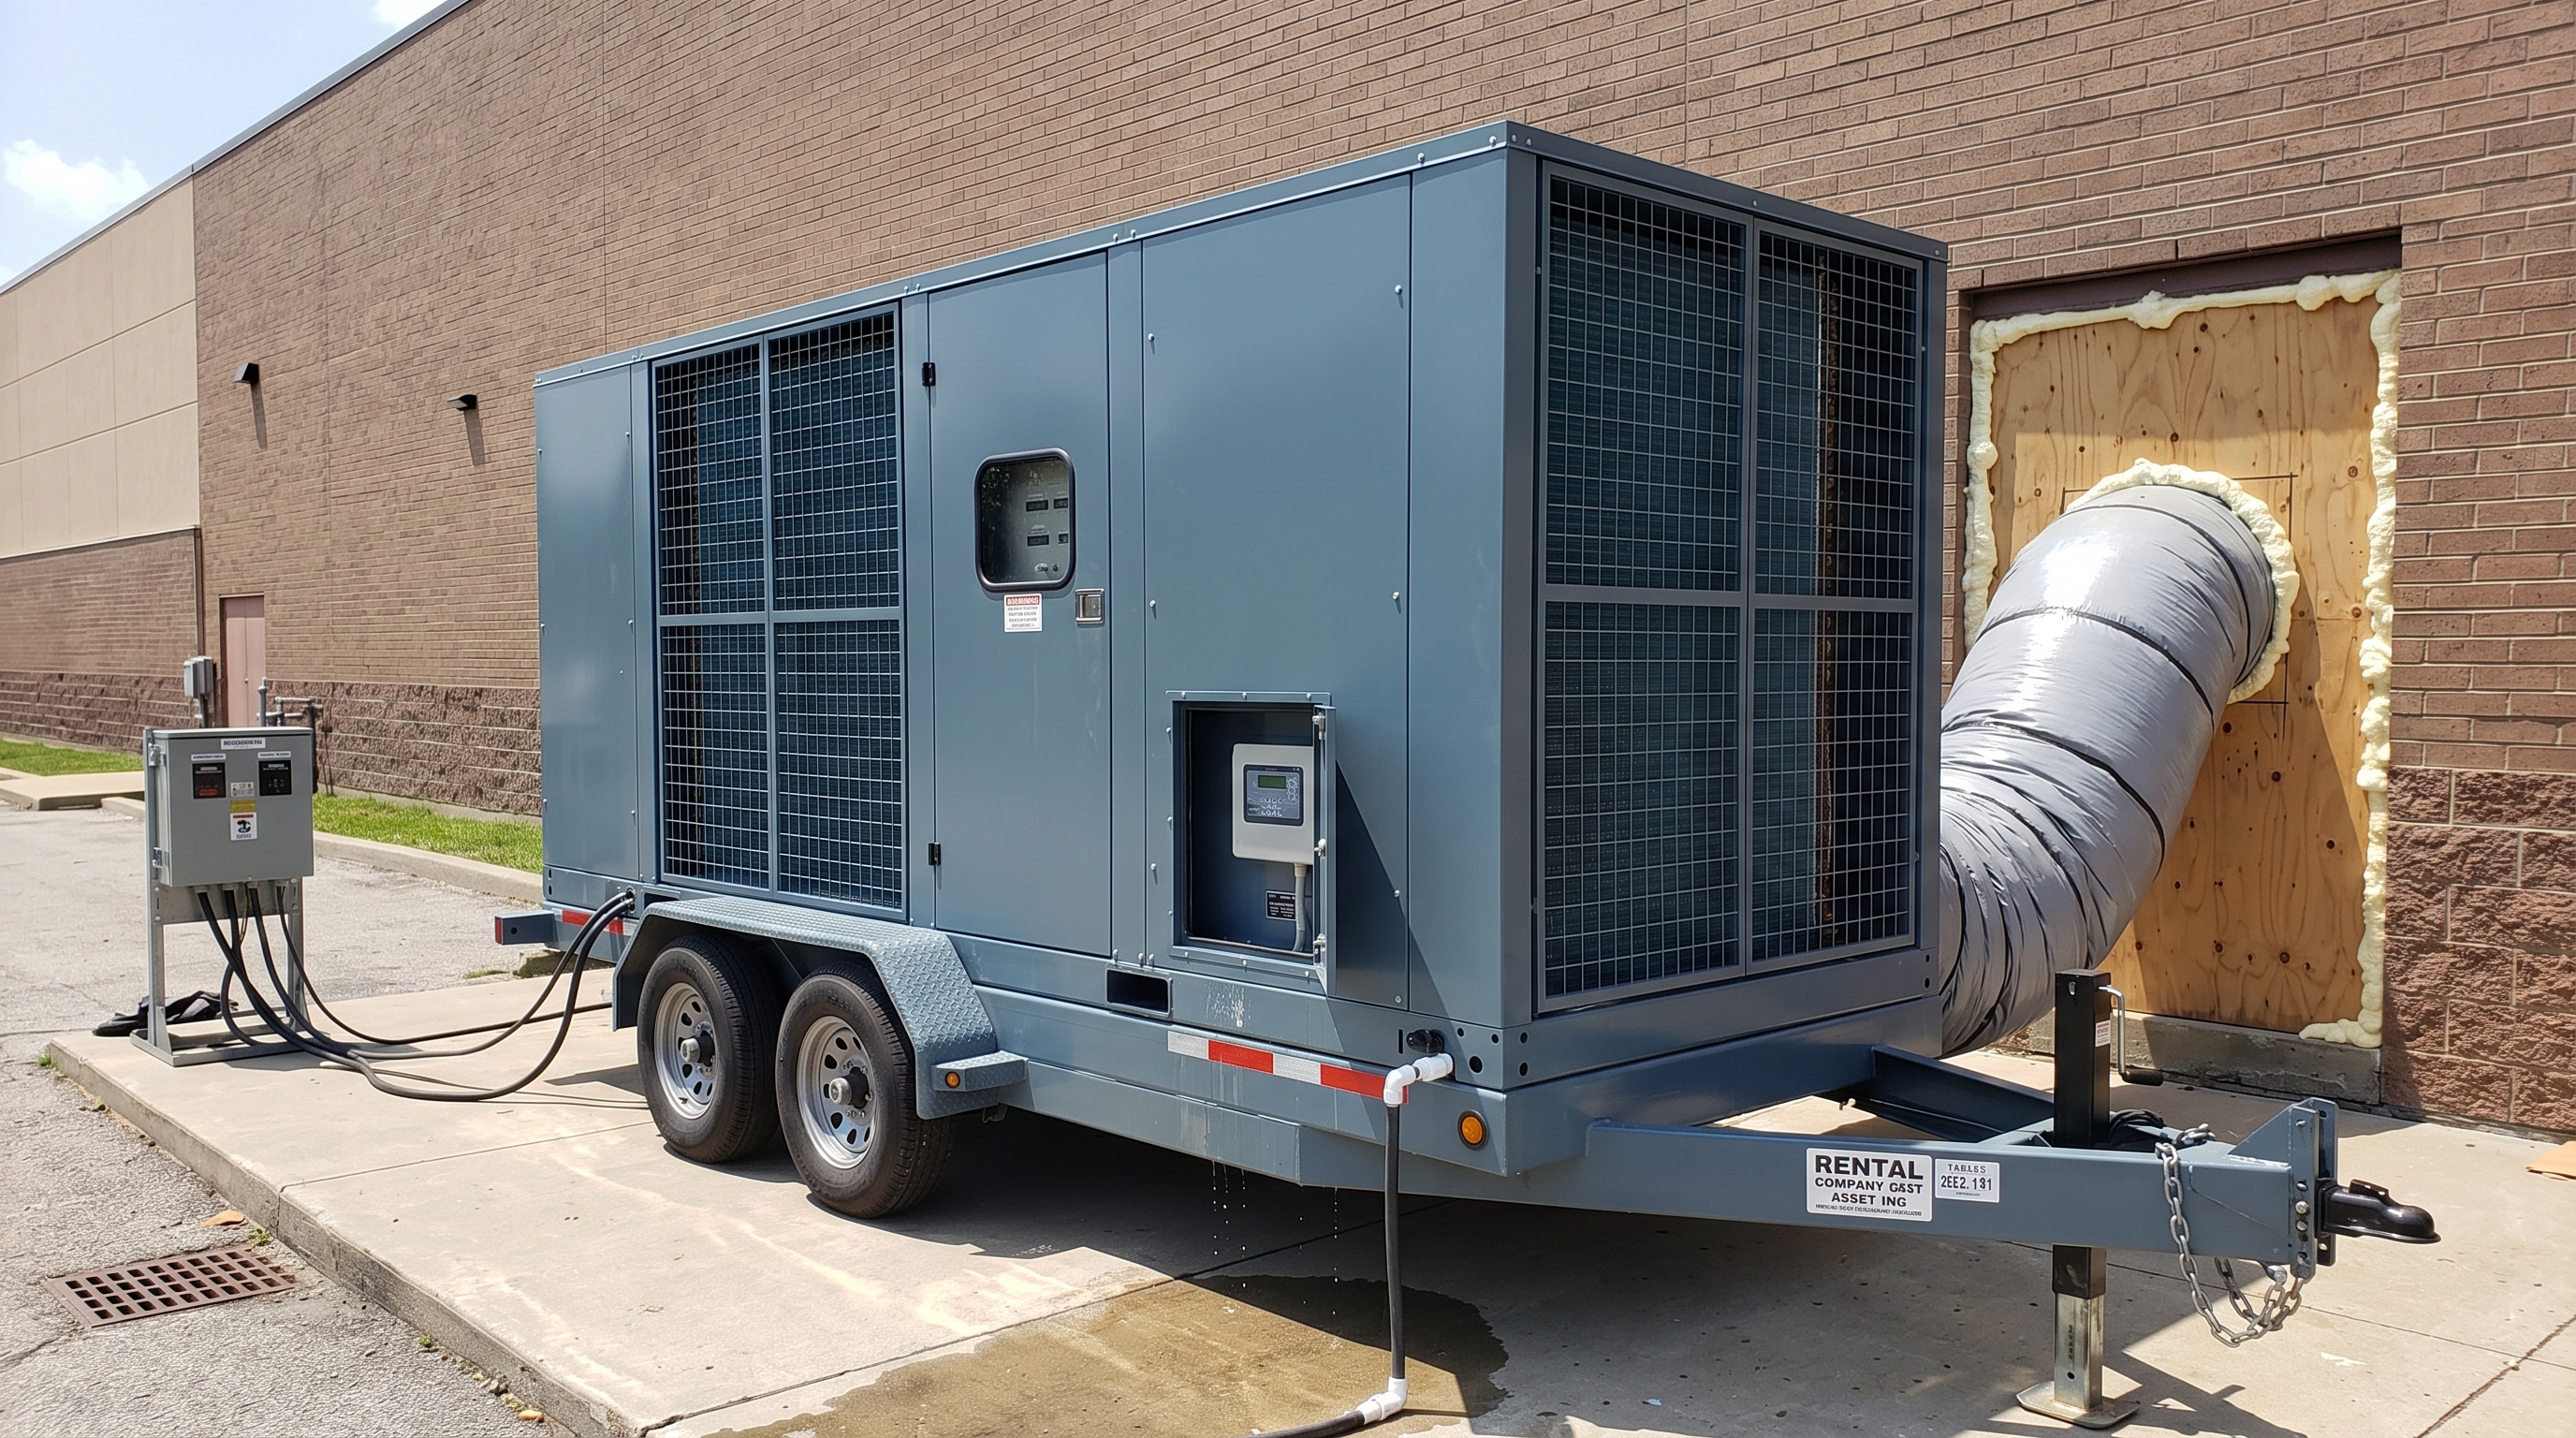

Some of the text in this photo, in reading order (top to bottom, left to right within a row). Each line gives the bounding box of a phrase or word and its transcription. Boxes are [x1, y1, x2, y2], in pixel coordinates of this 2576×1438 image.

[1815, 1154, 1924, 1180] RENTAL
[1814, 1177, 1884, 1192] COMPANY
[1831, 1192, 1907, 1208] ASSET ING
